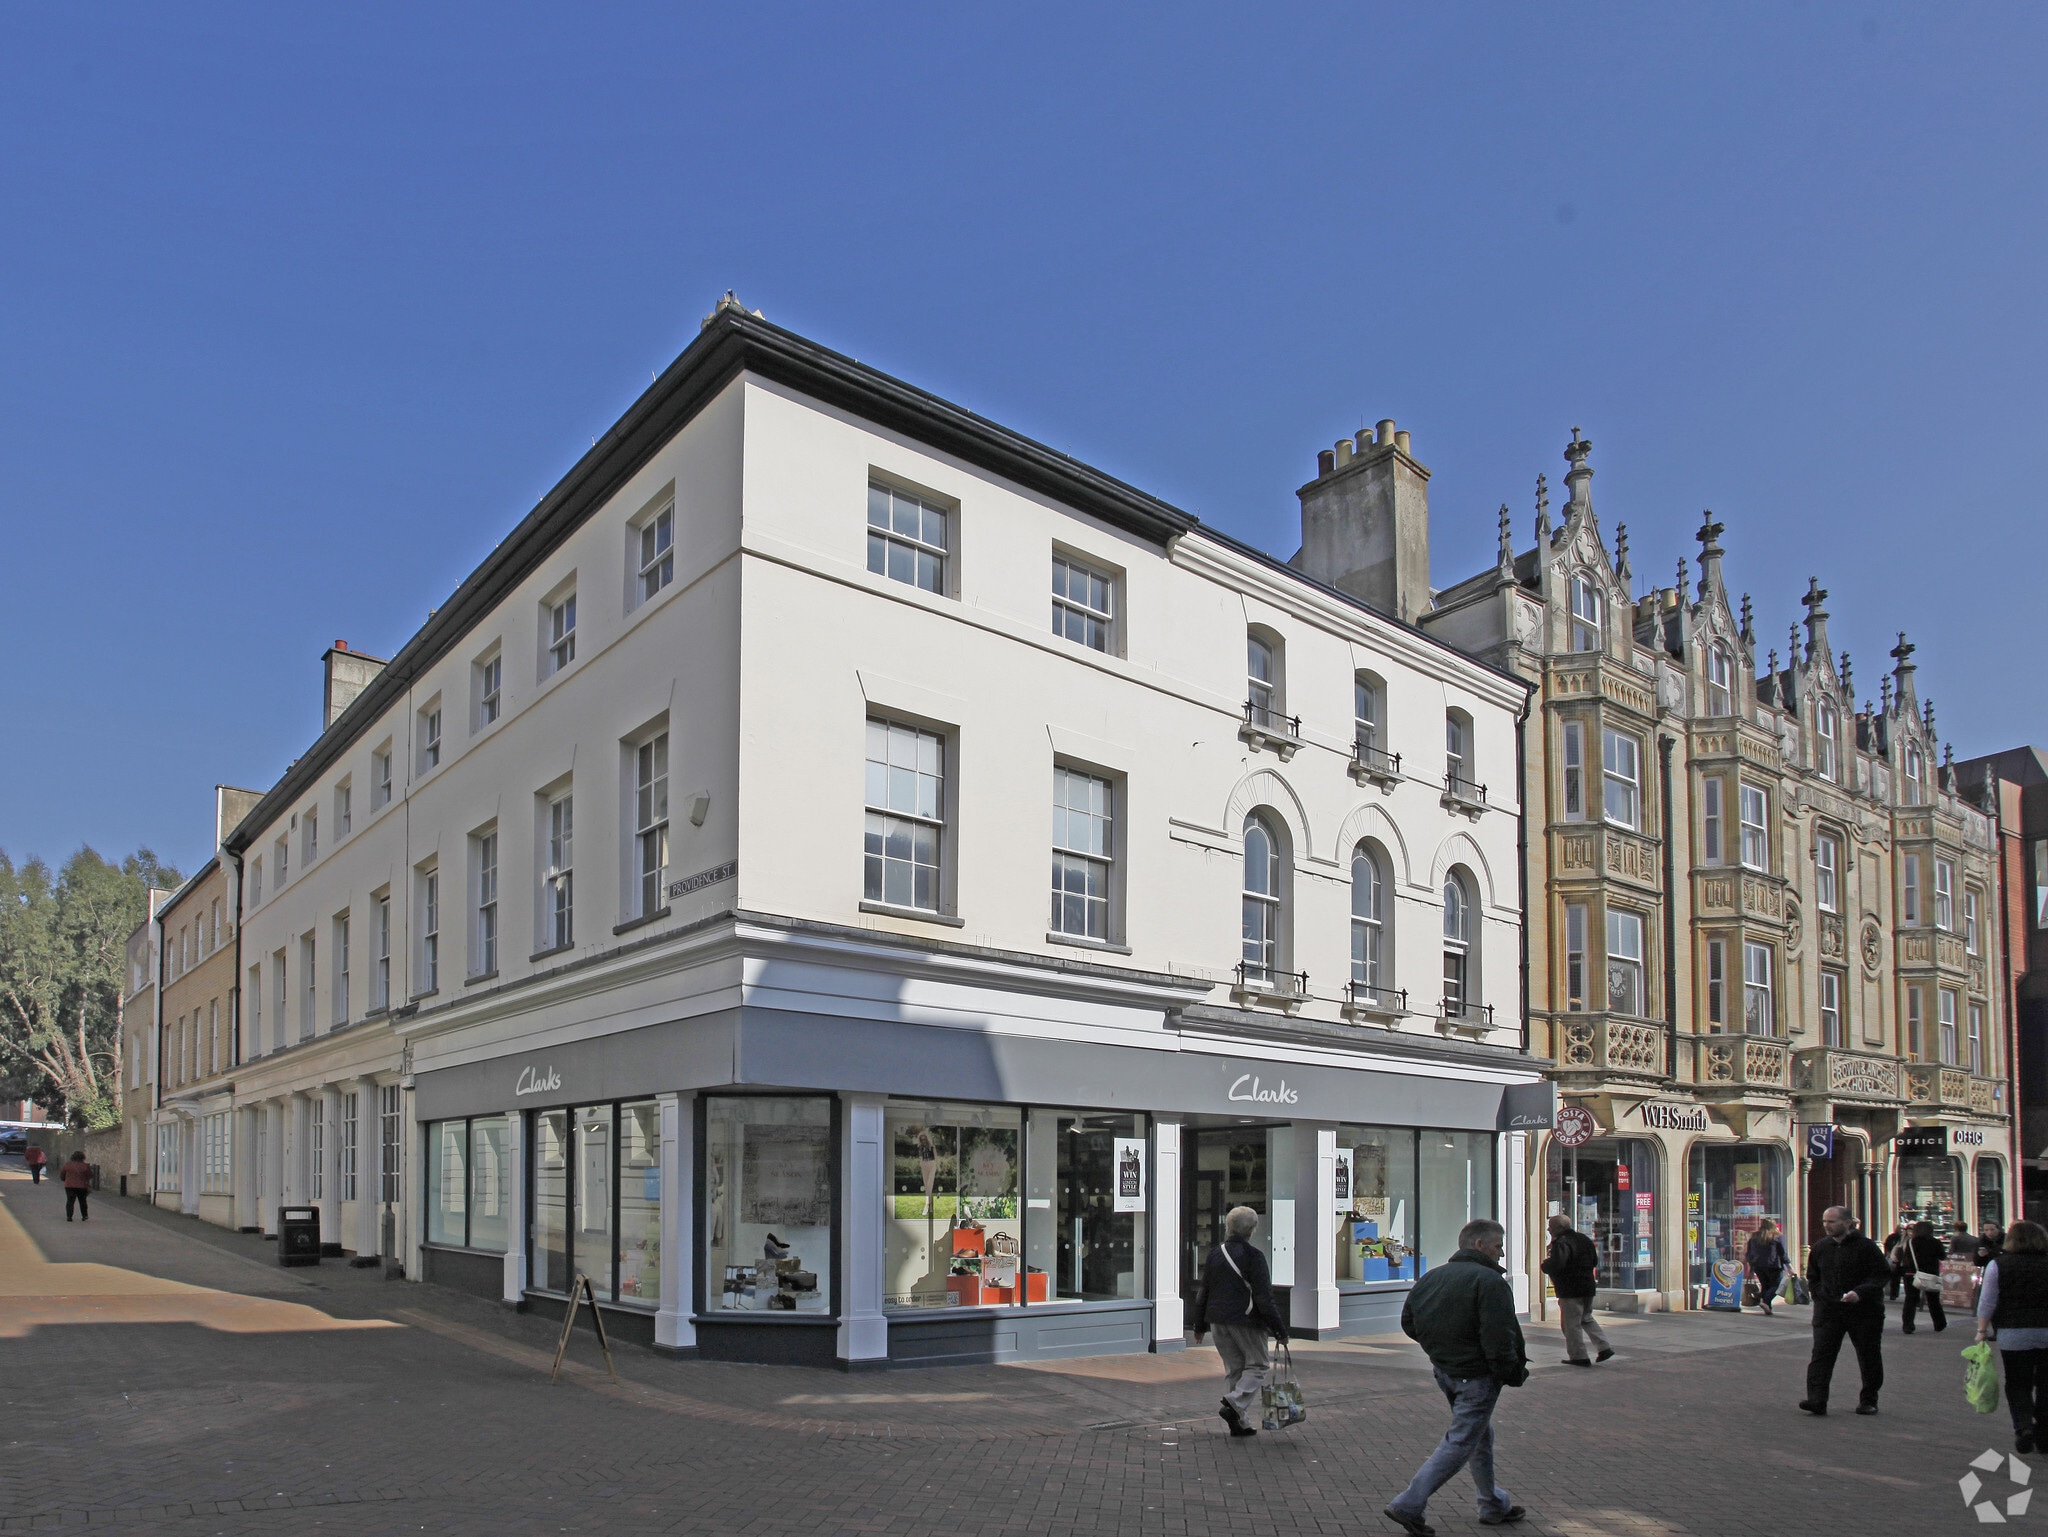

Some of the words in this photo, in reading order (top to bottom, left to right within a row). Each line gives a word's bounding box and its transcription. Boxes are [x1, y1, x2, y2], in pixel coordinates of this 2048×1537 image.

[672, 869, 718, 896] PROVIDENCE
[722, 864, 732, 878] ST
[516, 1065, 561, 1096] Clarks
[1851, 1078, 1876, 1092] HOTEL
[1228, 1073, 1298, 1104] Clarks
[1510, 1114, 1549, 1126] Clarks
[1557, 1110, 1585, 1121] COSTA
[1642, 1105, 1708, 1131] WHSmith
[1555, 1130, 1588, 1144] COFFEE
[1811, 1127, 1828, 1135] WH
[1810, 1134, 1828, 1157] S
[1896, 1137, 1943, 1146] OFFICE
[1123, 1171, 1137, 1179] WIN
[1636, 1198, 1651, 1206] FREE
[1688, 1193, 1700, 1201] AVE
[884, 1297, 898, 1305] easy
[906, 1295, 922, 1303] order
